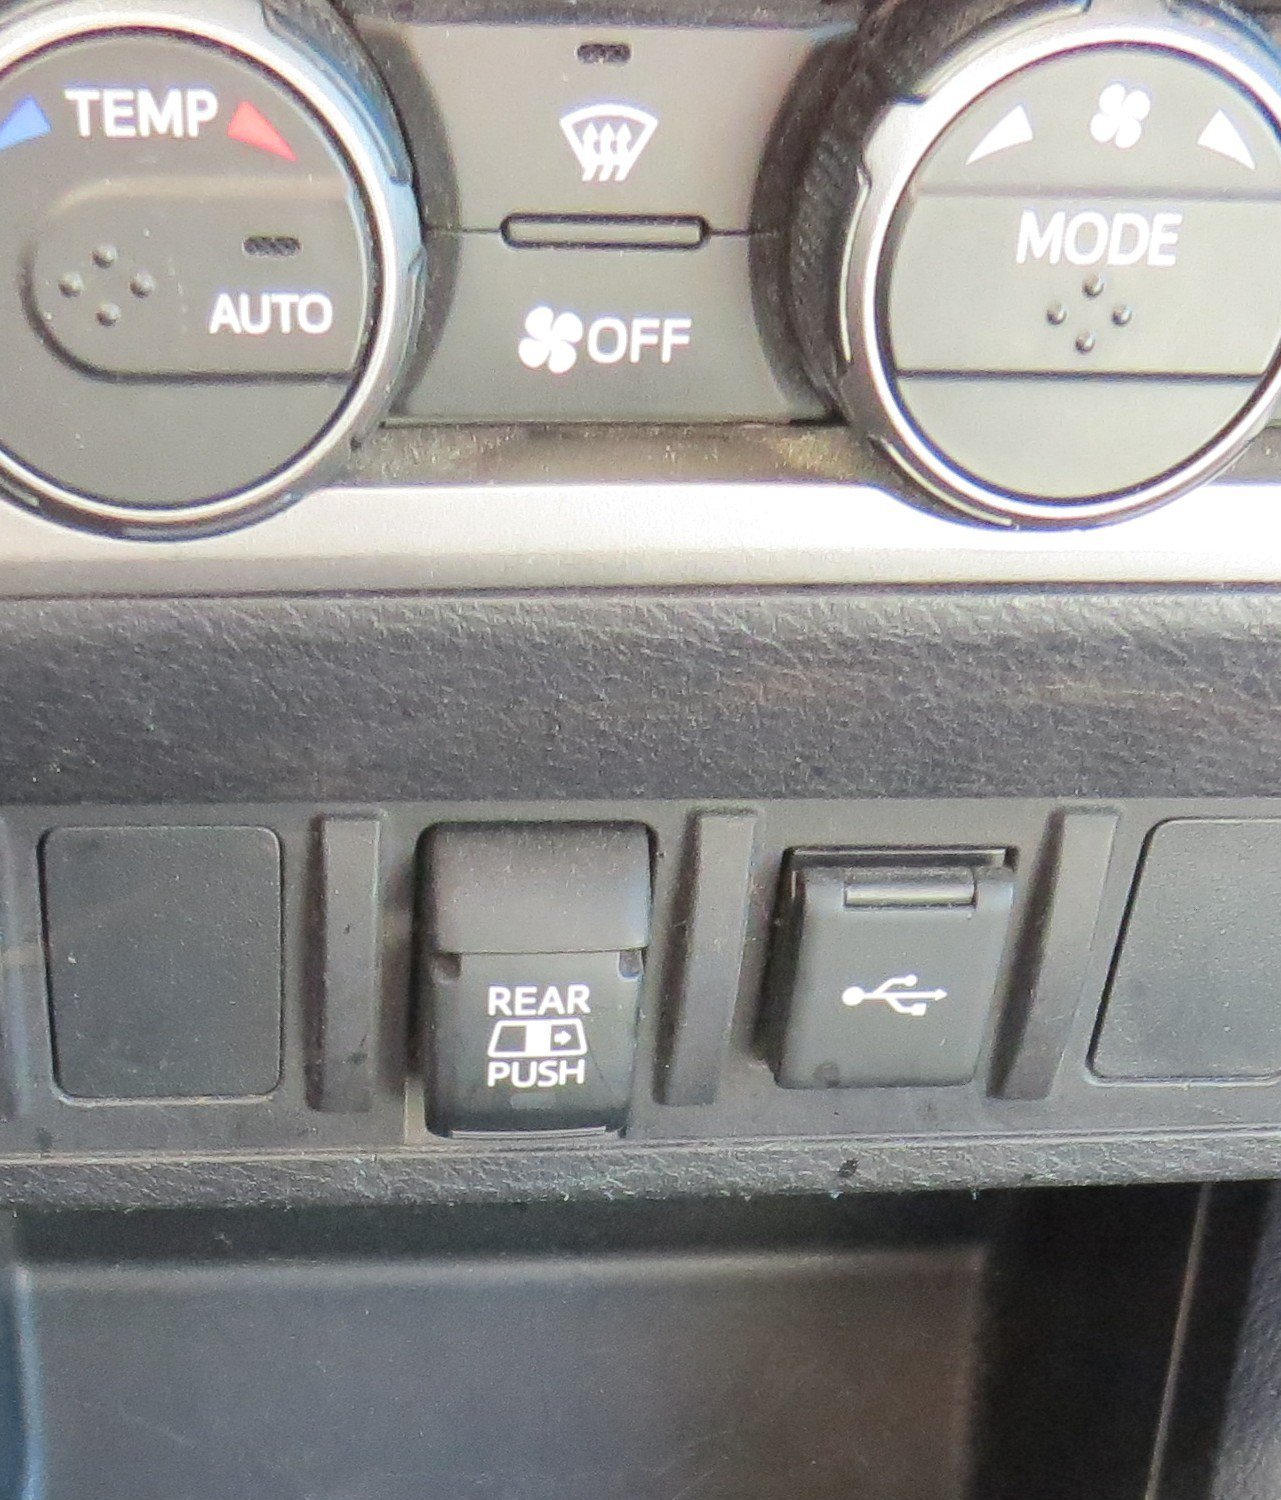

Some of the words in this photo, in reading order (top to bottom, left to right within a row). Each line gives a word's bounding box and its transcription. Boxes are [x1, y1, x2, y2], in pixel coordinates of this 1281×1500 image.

[65, 88, 219, 140] TEMP
[1015, 211, 1183, 268] MODE
[208, 292, 334, 337] AUTO
[587, 317, 692, 365] OFF
[487, 985, 591, 1016] REAR
[487, 1060, 586, 1088] PUSH
